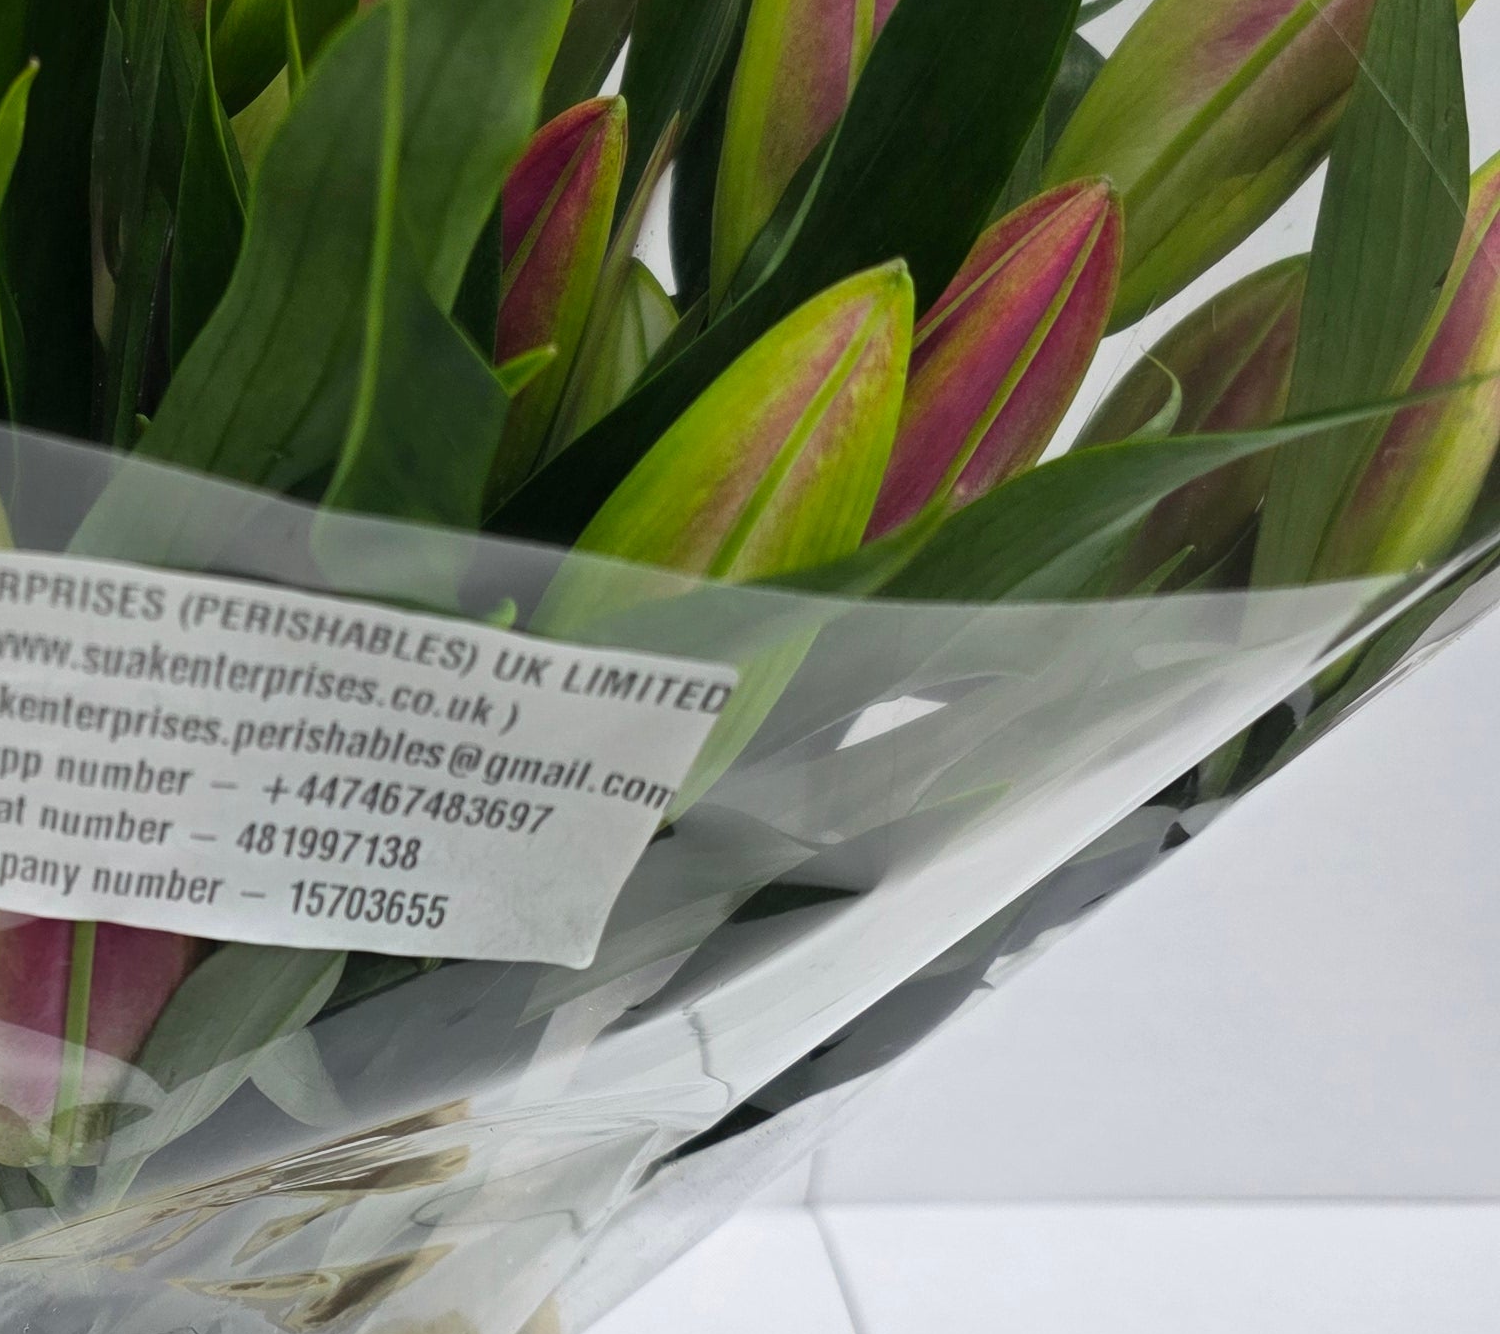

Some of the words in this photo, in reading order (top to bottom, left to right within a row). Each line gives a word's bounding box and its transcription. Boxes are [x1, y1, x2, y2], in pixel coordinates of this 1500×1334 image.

[178, 591, 480, 677] (PERISHABLES)
[491, 648, 547, 688] UK
[562, 659, 733, 715] LIMITED
[499, 701, 521, 737] )
[55, 754, 194, 796] number
[262, 772, 555, 836] +447467483697
[38, 805, 174, 845] number
[235, 821, 423, 871] 481997138
[91, 867, 226, 907] number
[289, 878, 450, 930] 15703655
